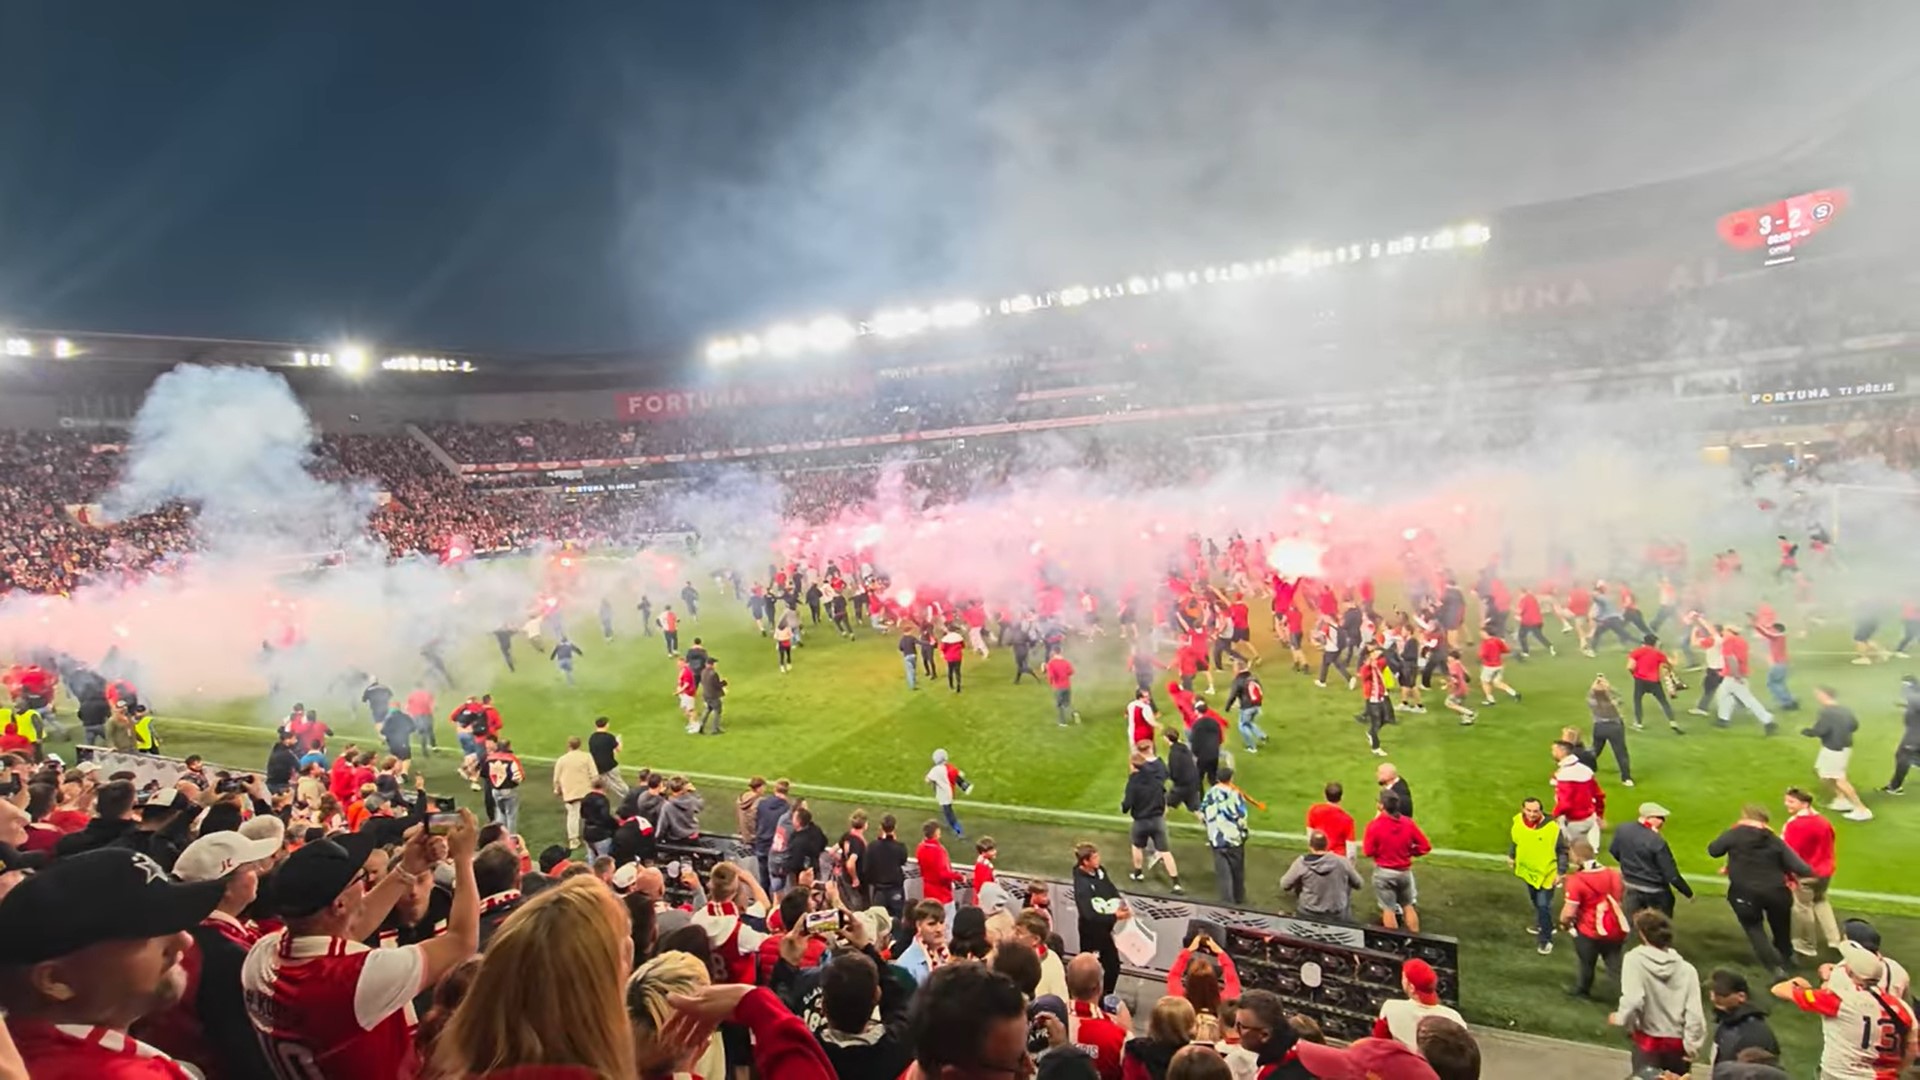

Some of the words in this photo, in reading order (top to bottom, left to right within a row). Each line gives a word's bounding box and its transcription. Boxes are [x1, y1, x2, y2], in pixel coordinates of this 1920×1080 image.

[1759, 215, 1772, 235] 3
[1788, 208, 1801, 229] 2
[627, 388, 748, 414] FORTUNA
[1751, 387, 1830, 404] FORTUNA
[1861, 1015, 1899, 1053] 13
